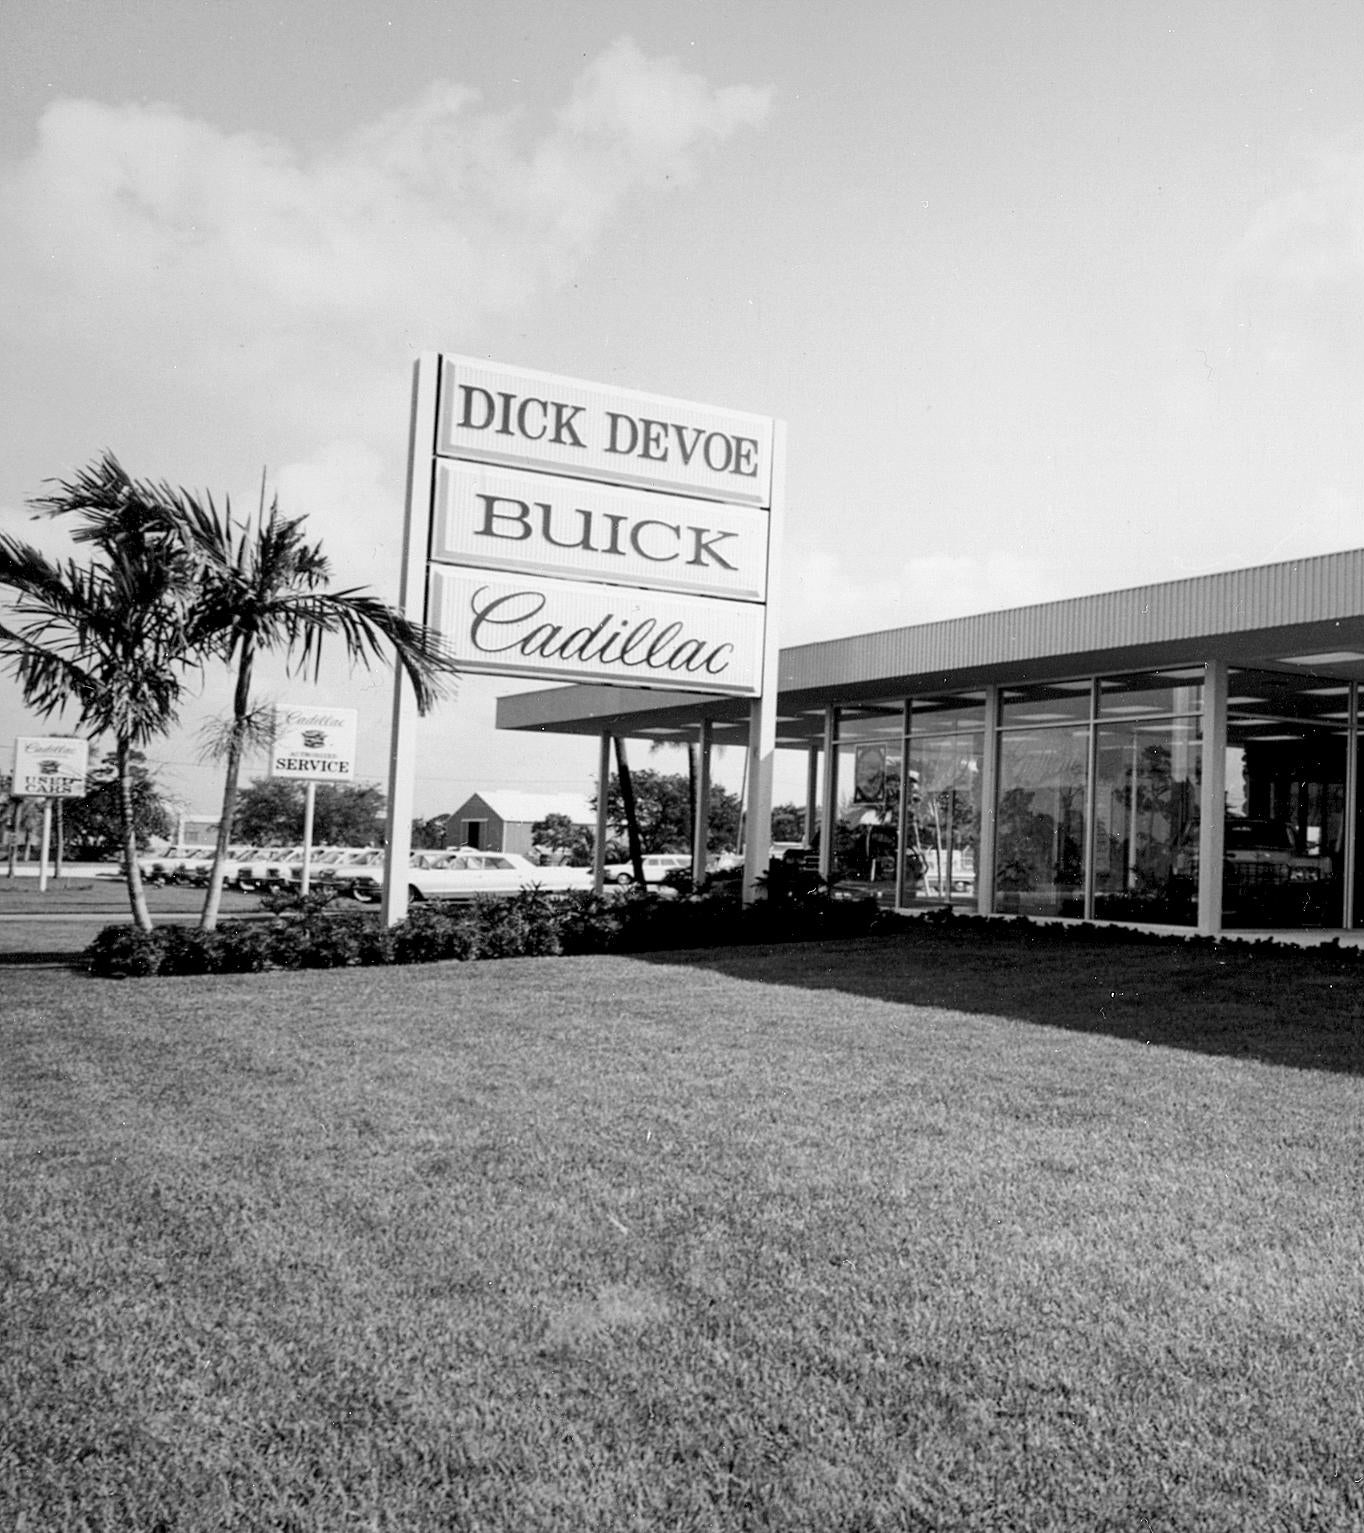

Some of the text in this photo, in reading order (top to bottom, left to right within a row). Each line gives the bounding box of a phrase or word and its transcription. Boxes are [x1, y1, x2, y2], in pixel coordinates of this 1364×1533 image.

[456, 384, 759, 478] DICK DEVOE
[473, 494, 739, 571] BUICK
[470, 585, 734, 674] Cadillac
[286, 710, 345, 727] Cadillac
[24, 784, 72, 793] CARS
[275, 758, 349, 773] SERVICE
